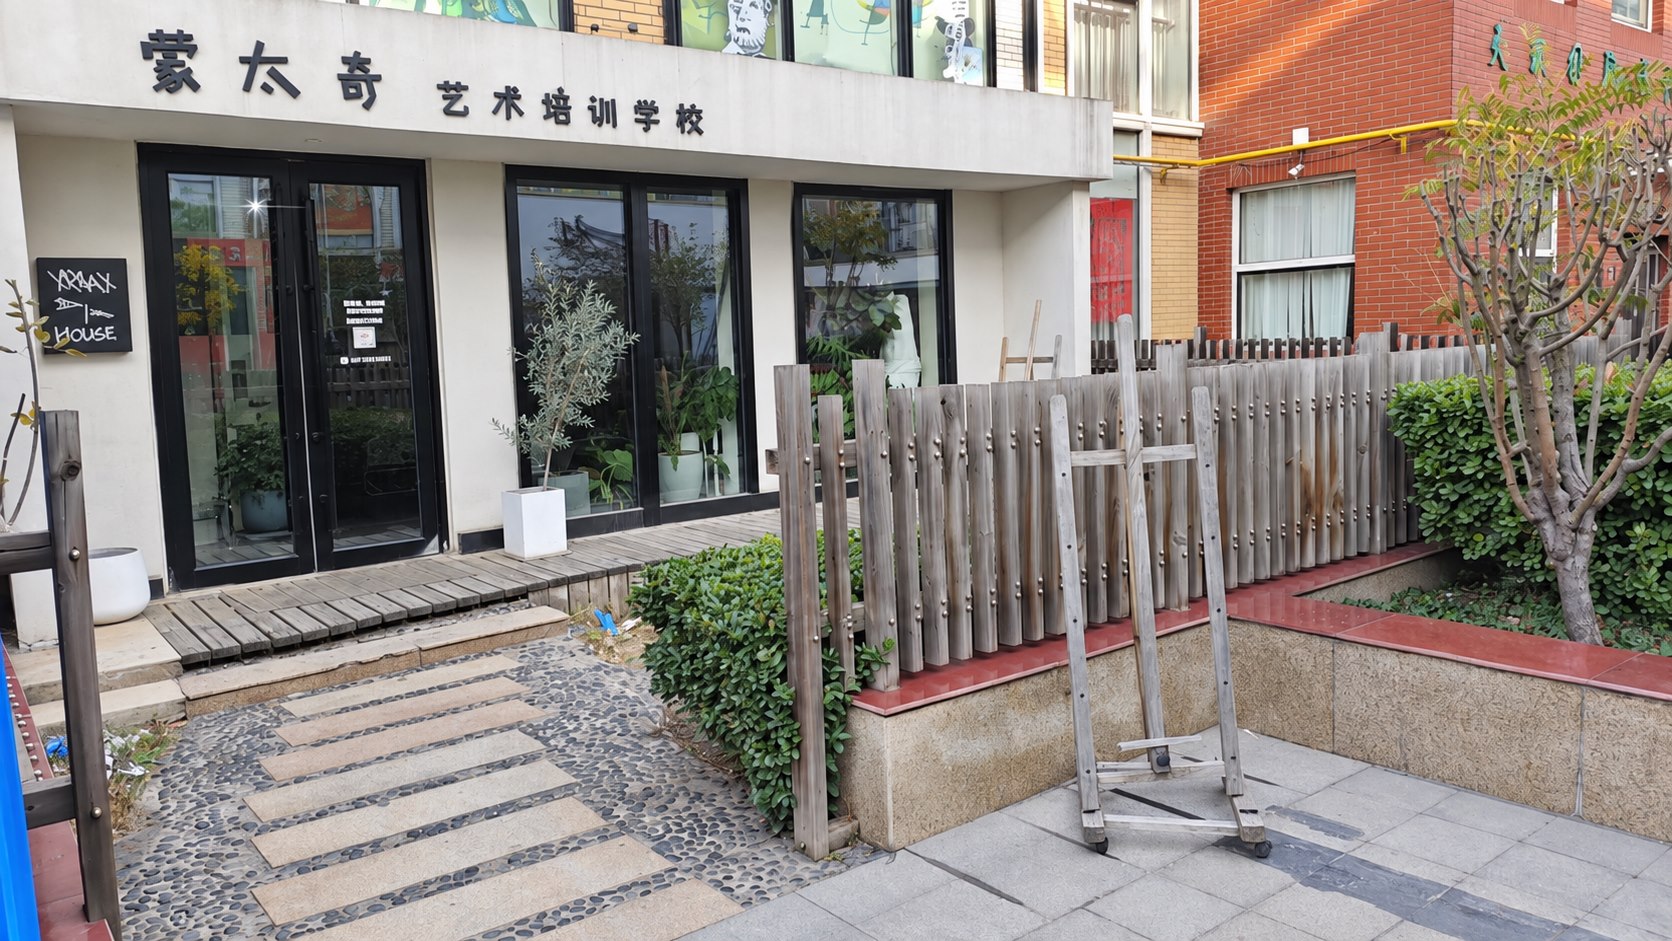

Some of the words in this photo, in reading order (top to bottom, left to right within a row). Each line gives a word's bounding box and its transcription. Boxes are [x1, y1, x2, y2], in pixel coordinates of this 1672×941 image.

[140, 29, 382, 111] 蒙太奇
[436, 80, 704, 136] 艺术培训学校
[54, 326, 117, 343] HOUSE
